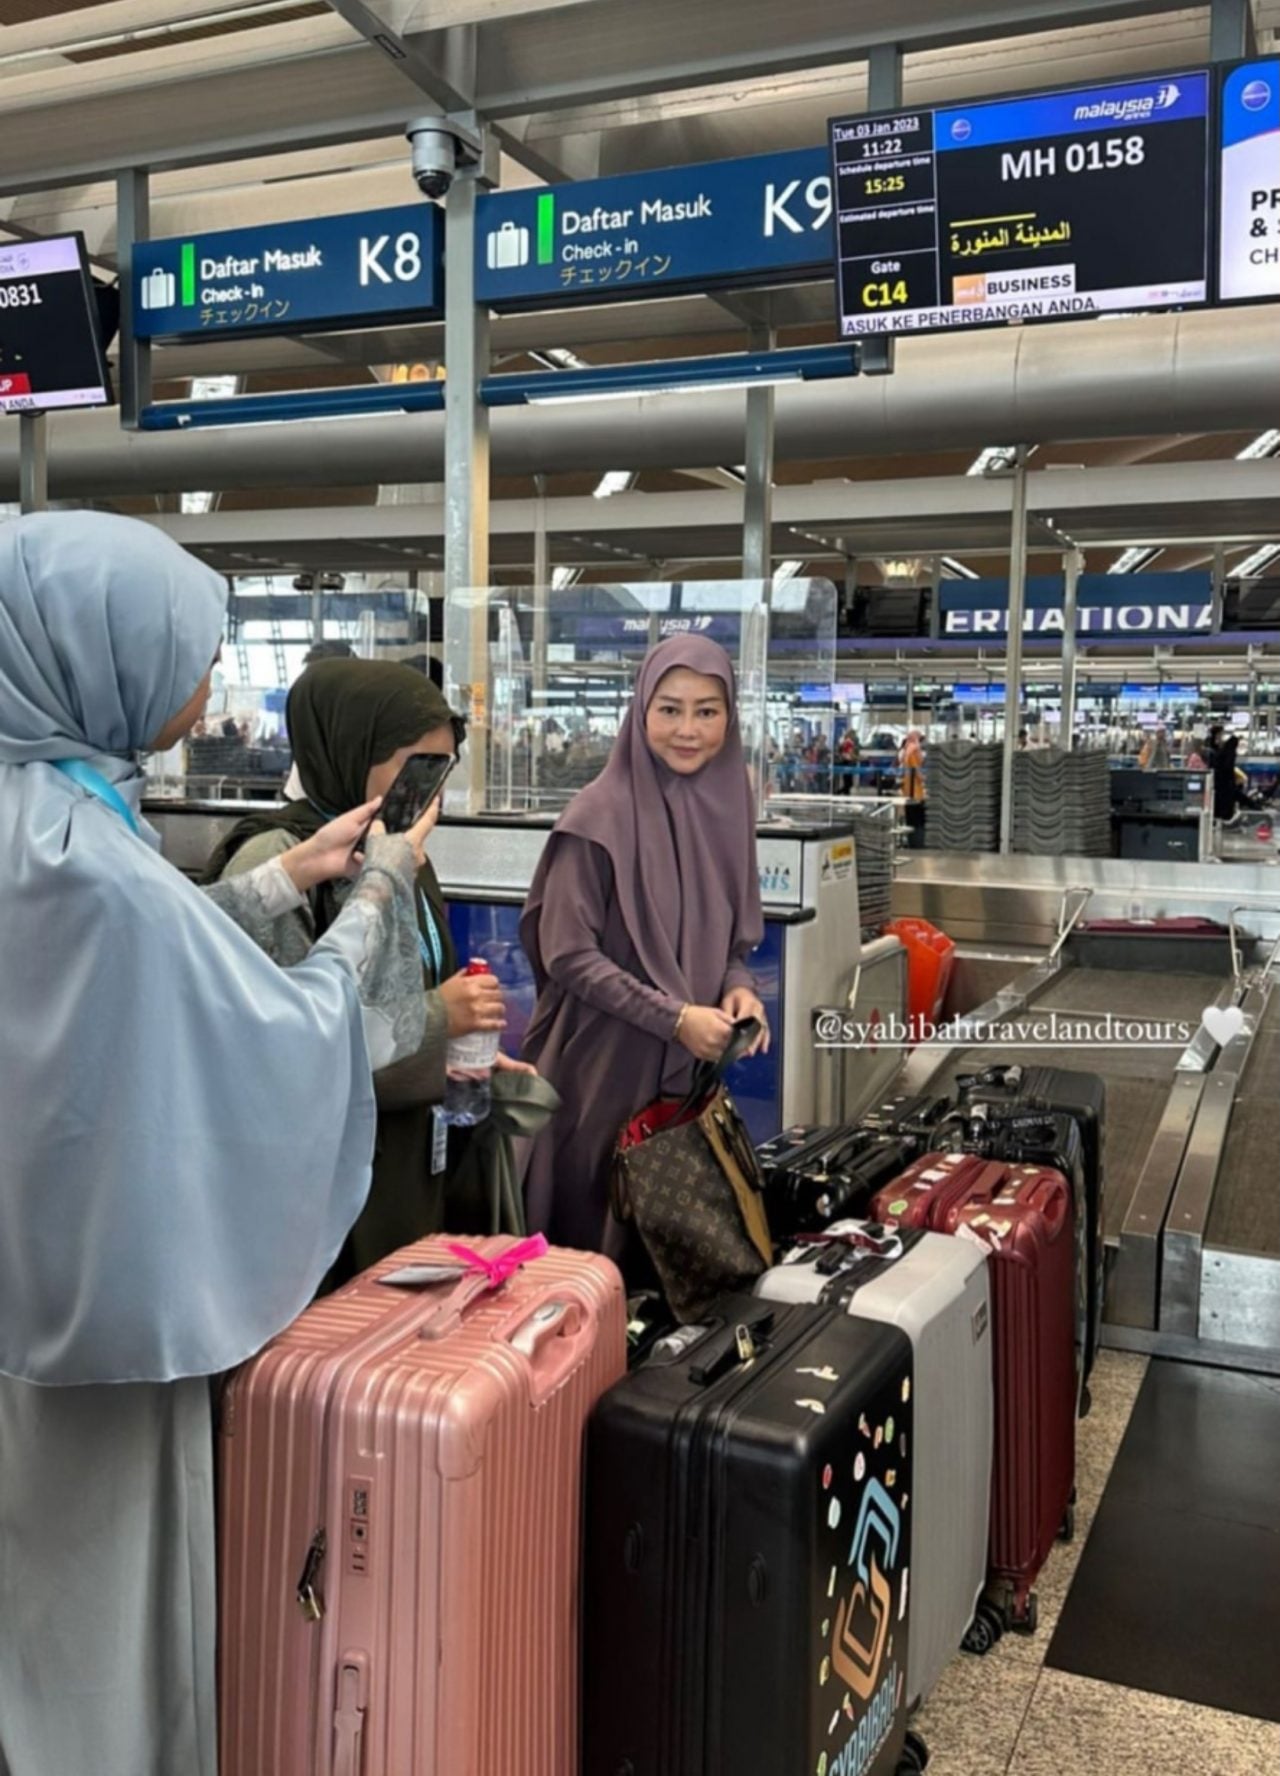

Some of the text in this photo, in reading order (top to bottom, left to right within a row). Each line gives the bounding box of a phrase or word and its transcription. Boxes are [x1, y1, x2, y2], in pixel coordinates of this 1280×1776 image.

[1073, 97, 1154, 120] malaysia
[834, 117, 919, 139] Tue 03 Jan 2023
[862, 139, 902, 157] 11:22
[1001, 135, 1145, 182] MH 0158
[865, 176, 905, 194] 15:25
[562, 194, 712, 235] Daftar Masuk
[764, 176, 832, 237] K9
[951, 221, 1071, 257] المدينة المنورة
[1249, 217, 1268, 238] &
[201, 244, 322, 280] Daftar Masuk
[359, 231, 422, 286] K8
[871, 260, 901, 275] Gate
[1249, 247, 1279, 265] CH
[560, 254, 672, 286] チェックイン
[0, 283, 43, 308] 0831
[862, 280, 909, 307] C14
[987, 274, 1072, 296] BUSINESS
[201, 300, 290, 326] チェックイン
[845, 315, 888, 334] ASUK
[892, 312, 914, 328] KE
[917, 302, 1043, 326] PENERBANGAN
[623, 617, 692, 635] malysia
